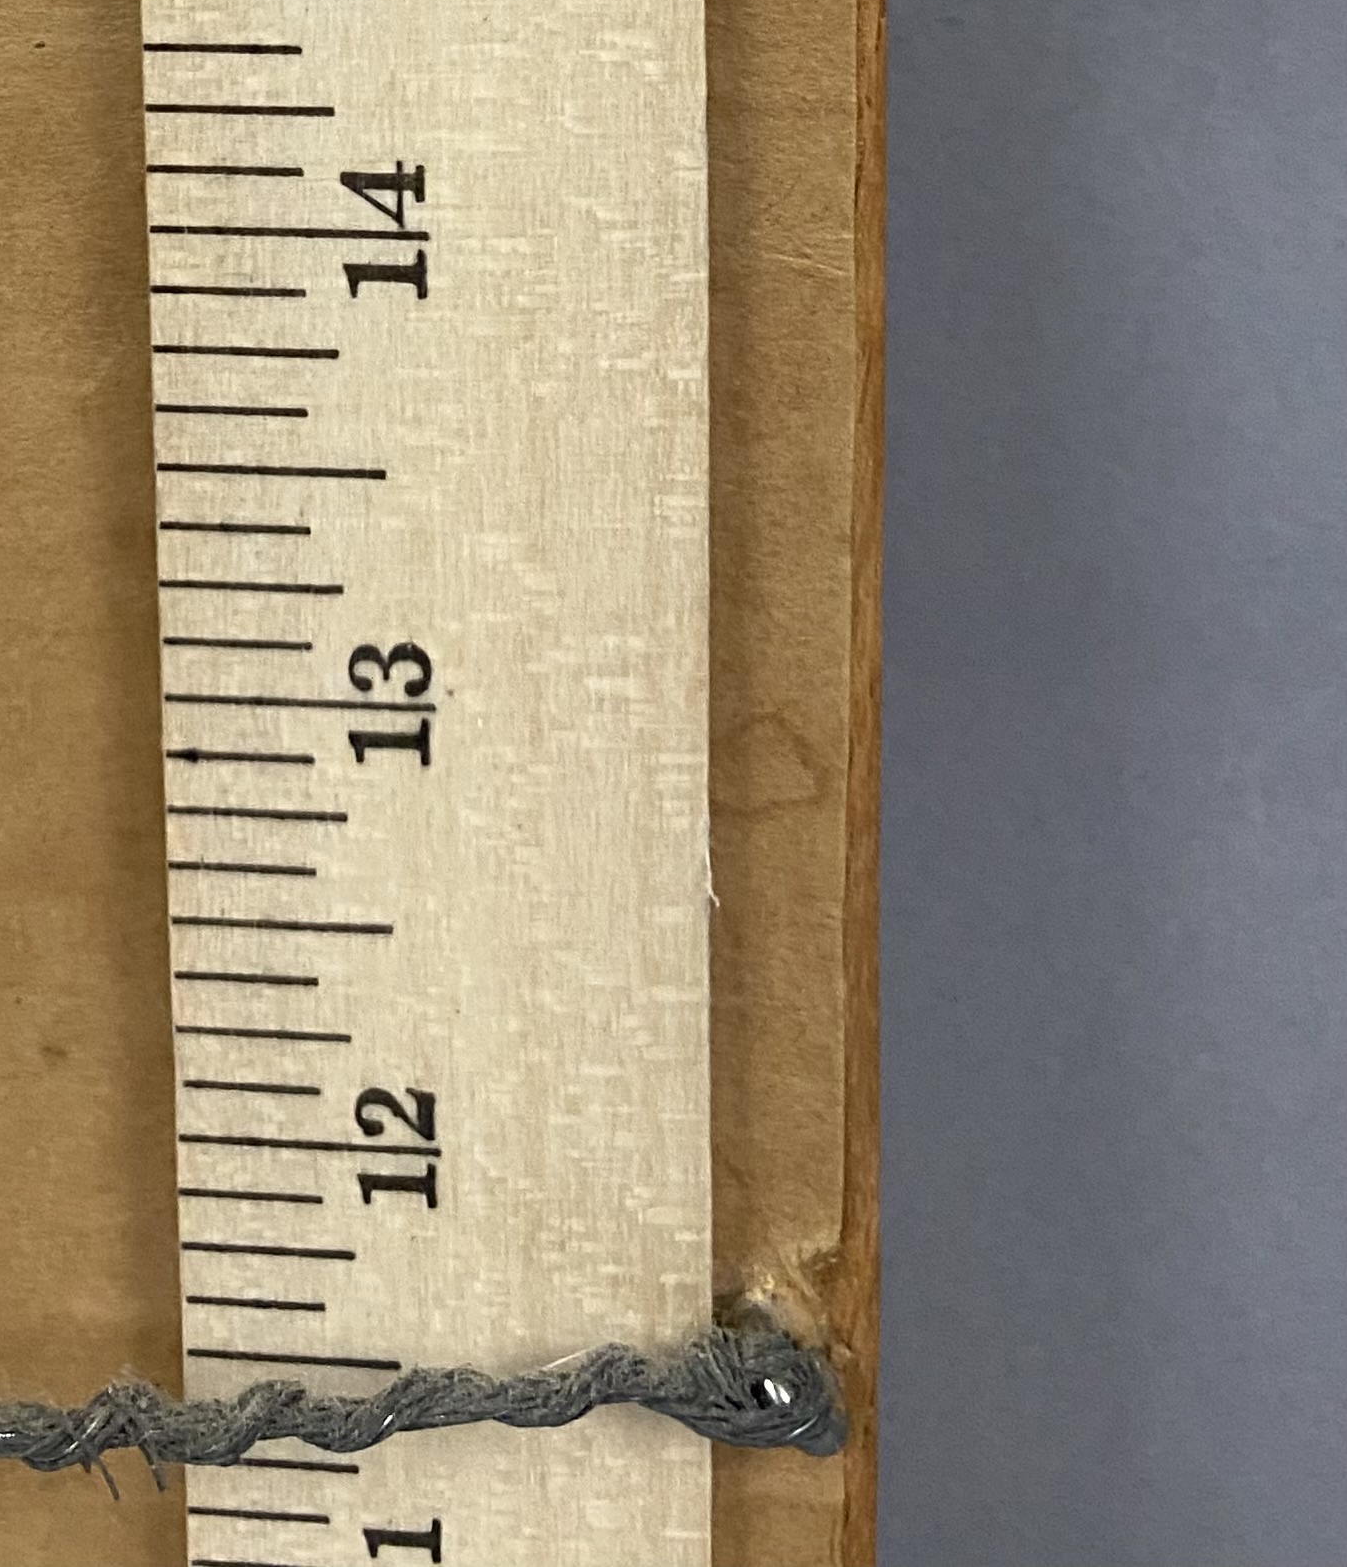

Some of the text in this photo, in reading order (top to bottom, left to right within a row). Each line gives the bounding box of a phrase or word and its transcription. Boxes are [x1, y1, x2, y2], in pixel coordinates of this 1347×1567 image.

[339, 160, 428, 300] 14
[348, 640, 434, 768] 13
[354, 1086, 439, 1209] 12
